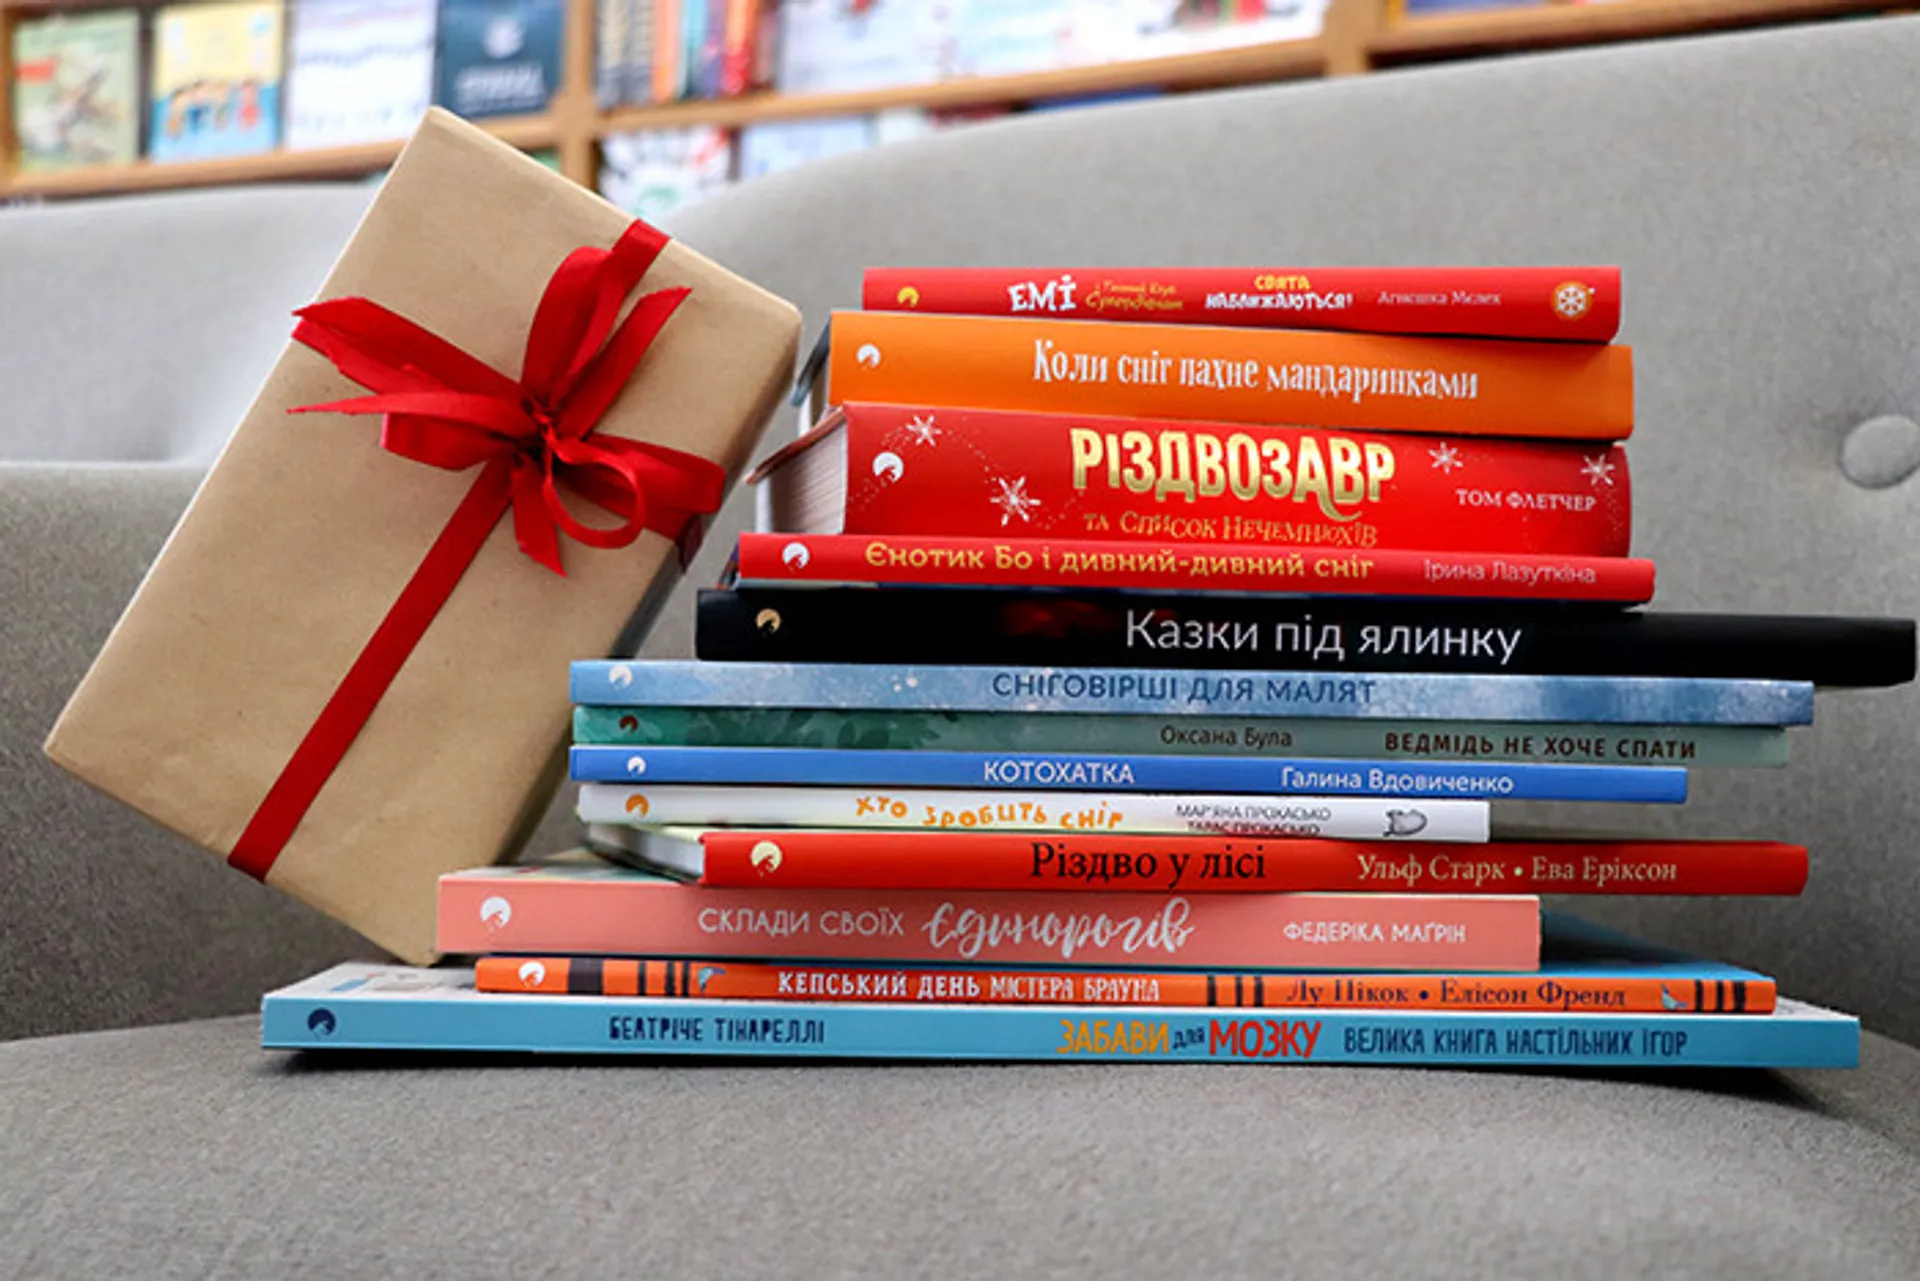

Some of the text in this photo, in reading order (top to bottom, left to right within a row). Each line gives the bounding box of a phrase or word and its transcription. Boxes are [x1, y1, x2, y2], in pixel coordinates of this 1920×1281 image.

[1007, 274, 1077, 312] ЕМІ
[1254, 274, 1311, 291] СВЯТА
[1032, 339, 1479, 404] Коли сніг пахне мандаринками
[1070, 427, 1396, 522] РІЗДВОЗАВР
[1456, 487, 1597, 512] ТОМ ФЛЕТЧЕР
[865, 541, 1375, 578] Єнотик Бо і дивний-дивний сніг
[1424, 559, 1597, 587] Ірина Лазуткіна
[1126, 609, 1522, 664] Казки під ялинку
[993, 671, 1378, 704] СНІГОВІРШІ ДЛЯ МАЛЯТ
[1160, 725, 1293, 750] Оксана Була
[1385, 732, 1696, 759] ВЕДМІДЬ НЕ ХОЧЕ СПАТИ
[983, 761, 1135, 785] КОТОХАТКА
[1281, 766, 1515, 794] Галина Вдовиченко
[1245, 805, 1332, 822] ПРОКАСЬКО
[1030, 842, 1266, 889] Різдво у лісі
[1357, 853, 1678, 887] Ульф Старк Ева Еріксон
[698, 907, 810, 938] СКЛАДИ
[819, 906, 904, 936] СВОЇХ
[1283, 921, 1385, 943] ФЕДЕРІКА
[777, 971, 1161, 1003] КЕПСЬКИЙ ДЕНЬ МІСТЕРА БРАУНА
[1286, 978, 1627, 1011] Лу Пікок Елісон Френд
[609, 1015, 826, 1044] БЕАТРІЧЕ ТІНАРЕЛЛІ
[1057, 1019, 1322, 1059] ЗАБАВИ для МОЗКУ
[1343, 1025, 1689, 1057] ВЕЛИКА КНИГА НАСТІЛЬНИХ ІГОР
